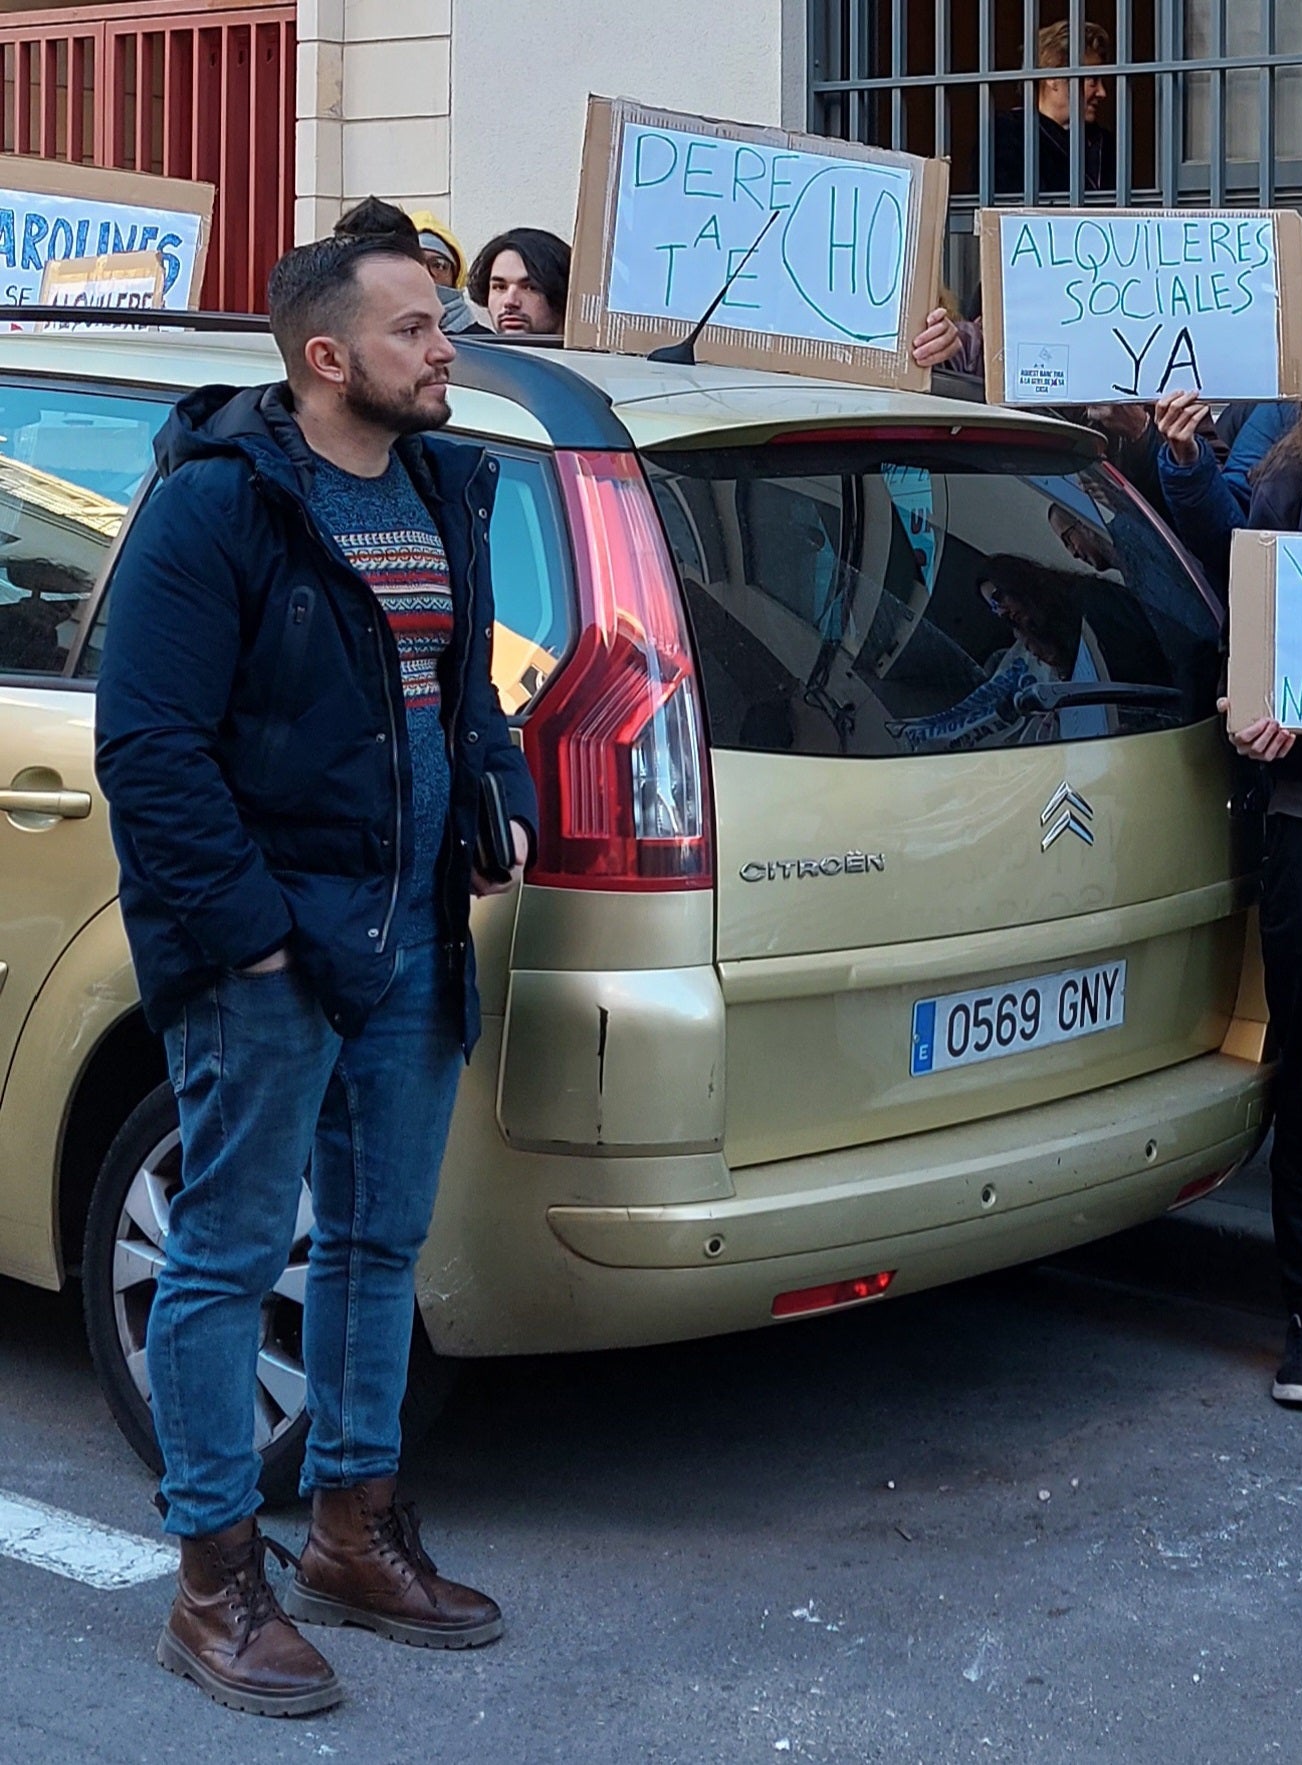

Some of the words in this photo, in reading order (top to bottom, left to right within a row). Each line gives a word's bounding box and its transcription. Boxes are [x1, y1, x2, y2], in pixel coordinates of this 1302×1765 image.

[1011, 219, 1271, 283] ALQUILERES
[1061, 269, 1253, 325] SOCIALES
[1112, 323, 1202, 395] YA
[739, 851, 886, 882] CITROËN
[947, 988, 1042, 1058] 0569
[1058, 967, 1121, 1031] GNY
[918, 1044, 929, 1061] E
